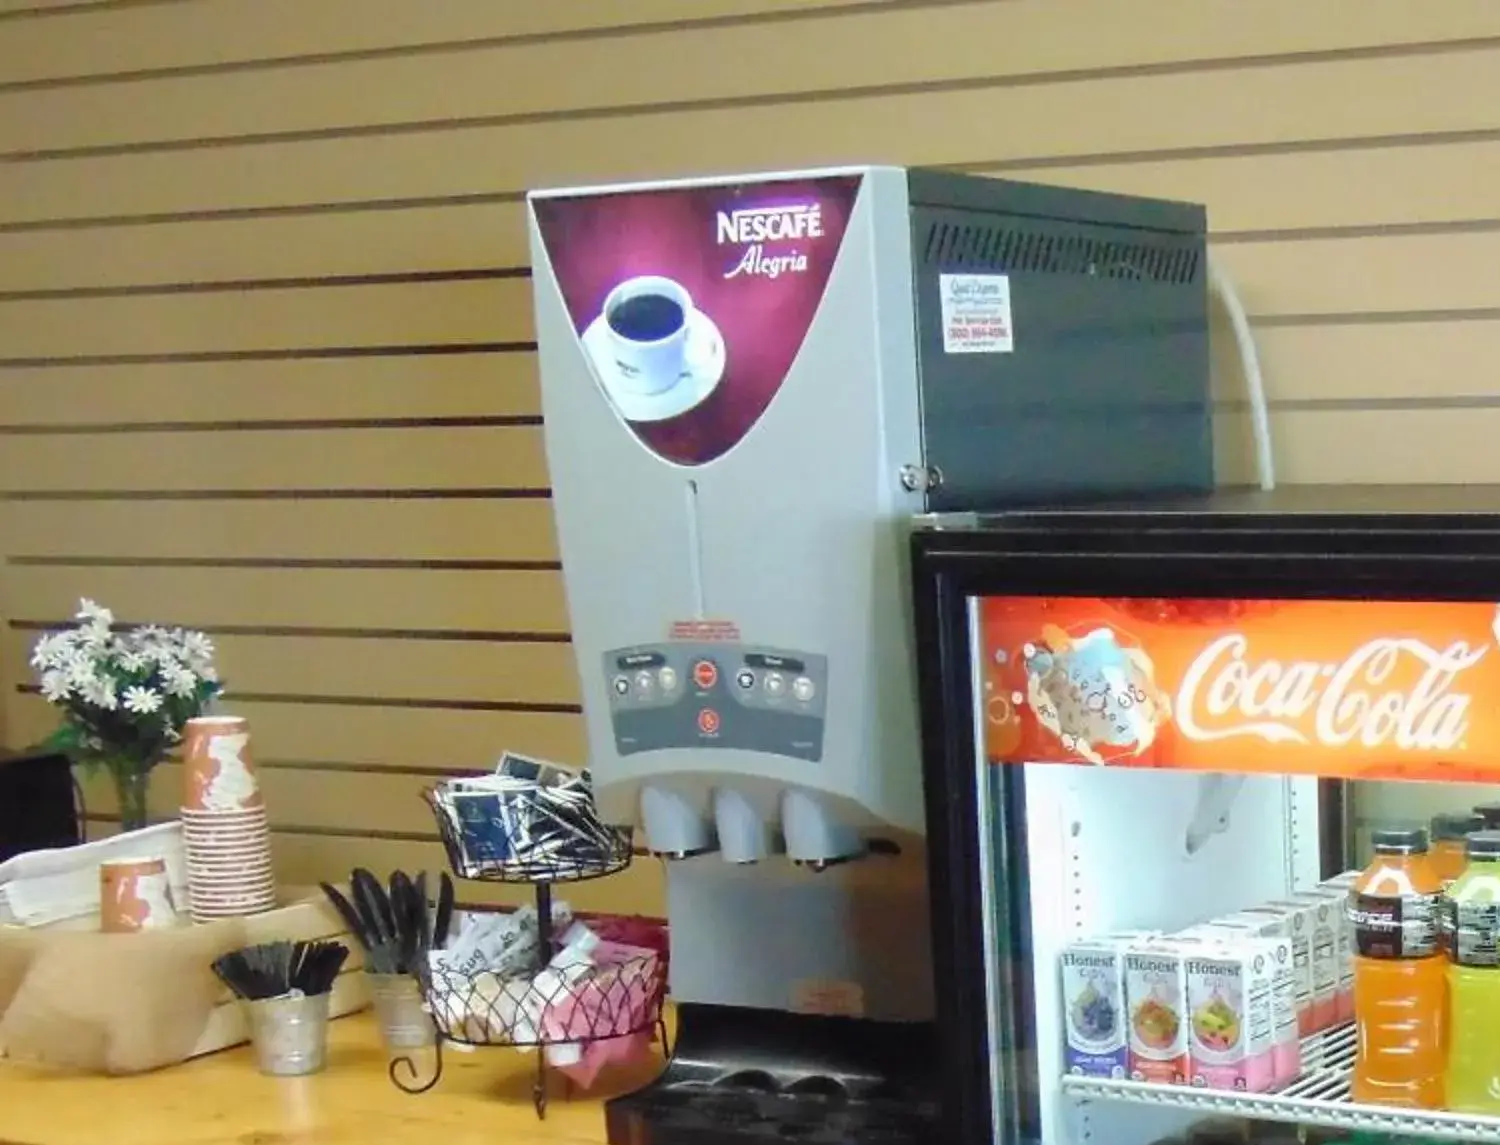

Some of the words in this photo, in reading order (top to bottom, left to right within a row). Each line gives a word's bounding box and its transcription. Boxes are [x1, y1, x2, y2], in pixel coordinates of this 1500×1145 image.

[717, 203, 824, 244] NESCAFÉ
[723, 244, 808, 278] Alegria
[1176, 633, 1488, 751] Coca-Cola
[1063, 953, 1115, 968] Honest
[1126, 957, 1179, 972] Honest
[1188, 961, 1240, 977] Honest
